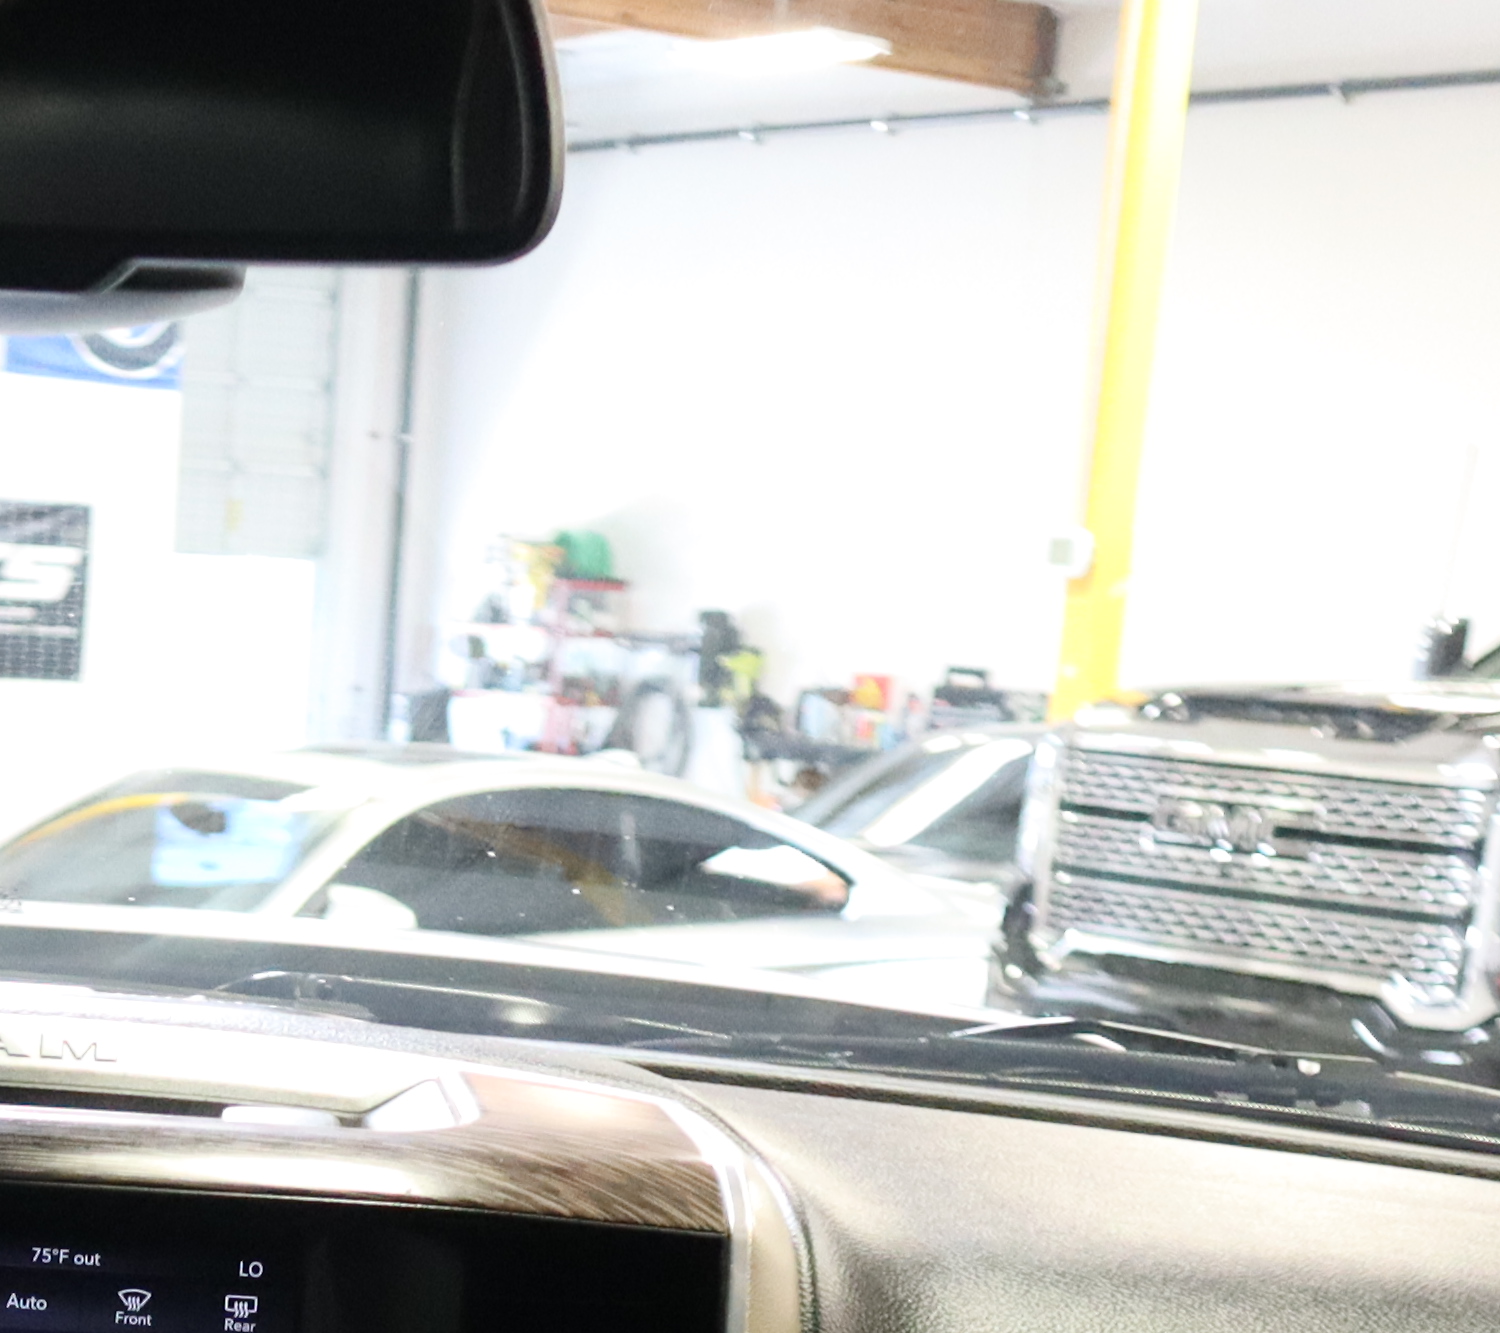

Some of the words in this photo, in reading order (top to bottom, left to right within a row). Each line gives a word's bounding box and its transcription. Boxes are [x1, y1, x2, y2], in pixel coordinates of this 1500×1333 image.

[30, 1246, 70, 1265] 75°F
[73, 1250, 101, 1267] out
[238, 1260, 264, 1279] LO
[5, 1292, 48, 1312] Auto
[114, 1310, 152, 1327] Front
[223, 1317, 257, 1333] Rear
